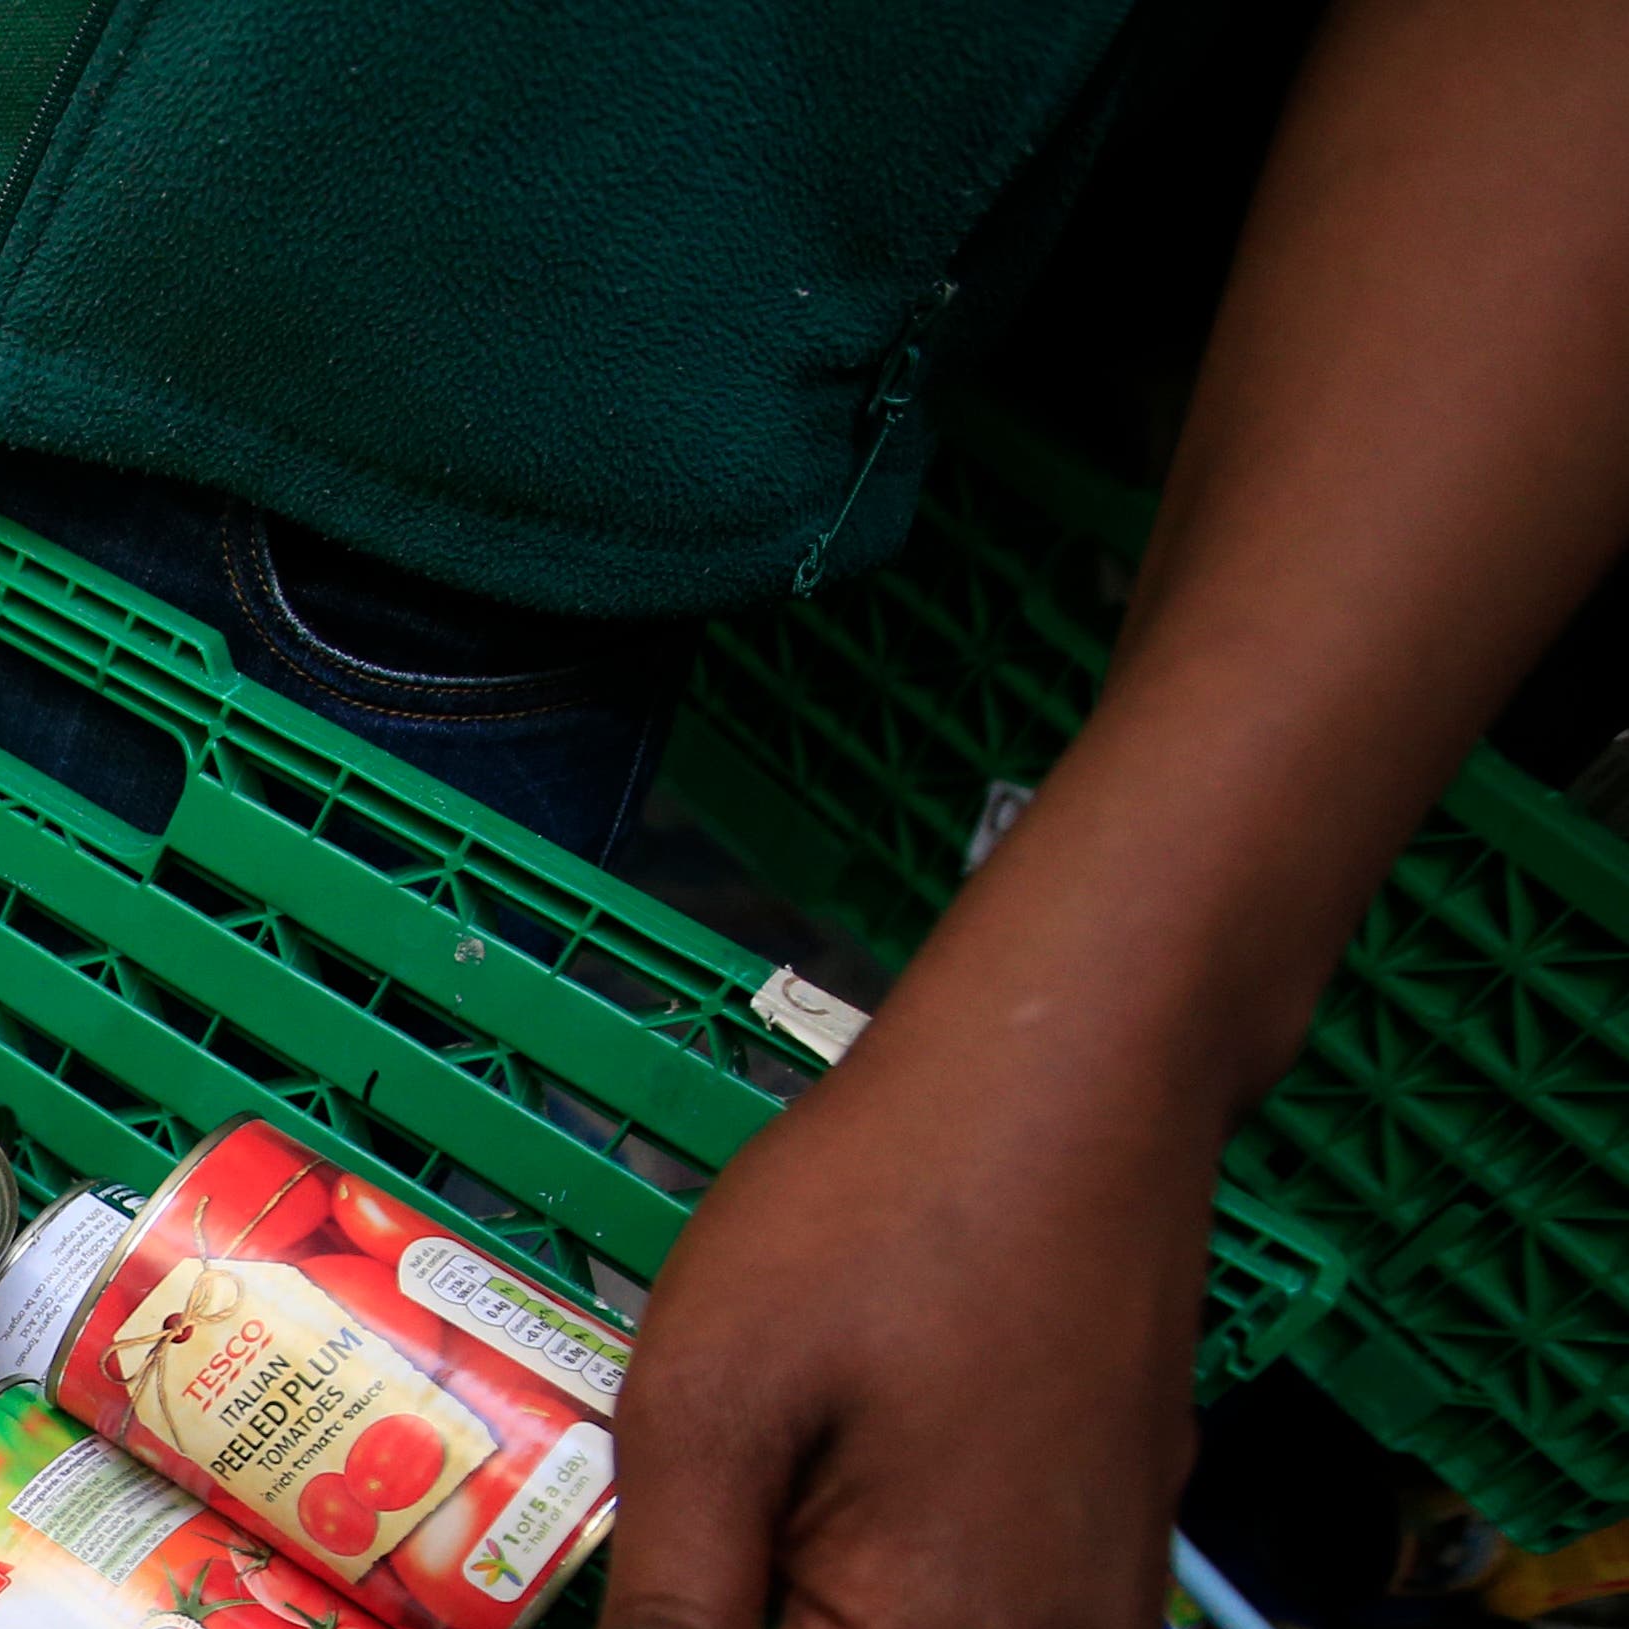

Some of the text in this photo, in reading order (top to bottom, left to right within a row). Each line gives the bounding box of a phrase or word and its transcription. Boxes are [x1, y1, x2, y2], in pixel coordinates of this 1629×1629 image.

[13, 1303, 63, 1369] Organic Tomato
[31, 1296, 55, 1320] Citric
[485, 1298, 510, 1320] 0.4g
[180, 1314, 269, 1405] TESCO
[217, 1353, 292, 1428] ITALIAN
[208, 1325, 364, 1482] PEELED PLUM
[255, 1383, 347, 1475] TOMATOES
[269, 1466, 298, 1494] rich
[291, 1418, 345, 1472] tomato
[341, 1377, 387, 1423] sauce
[513, 1511, 537, 1536] of
[551, 1447, 590, 1483] day
[528, 1520, 552, 1546] half
[567, 1473, 590, 1498] can
